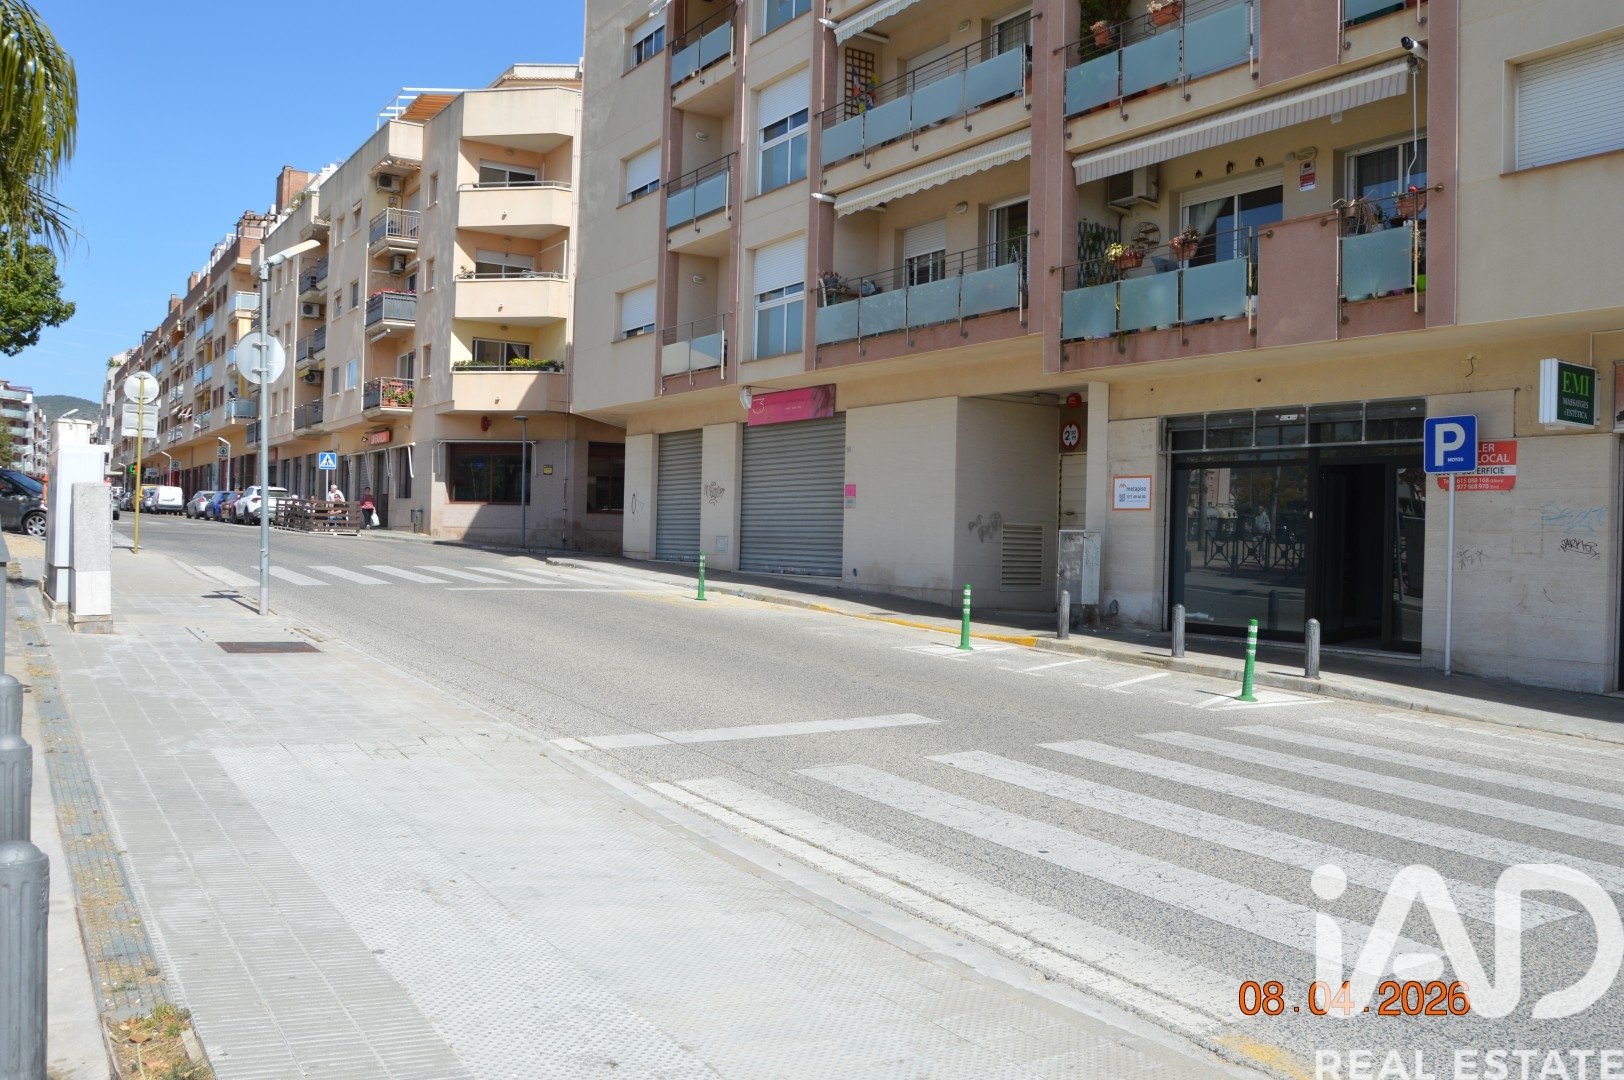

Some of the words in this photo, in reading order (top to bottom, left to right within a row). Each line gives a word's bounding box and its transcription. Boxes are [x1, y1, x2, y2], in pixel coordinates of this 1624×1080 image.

[1562, 371, 1589, 396] EMI
[1434, 422, 1466, 467] P
[1477, 443, 1495, 453] ER
[1477, 453, 1510, 464] OCAL
